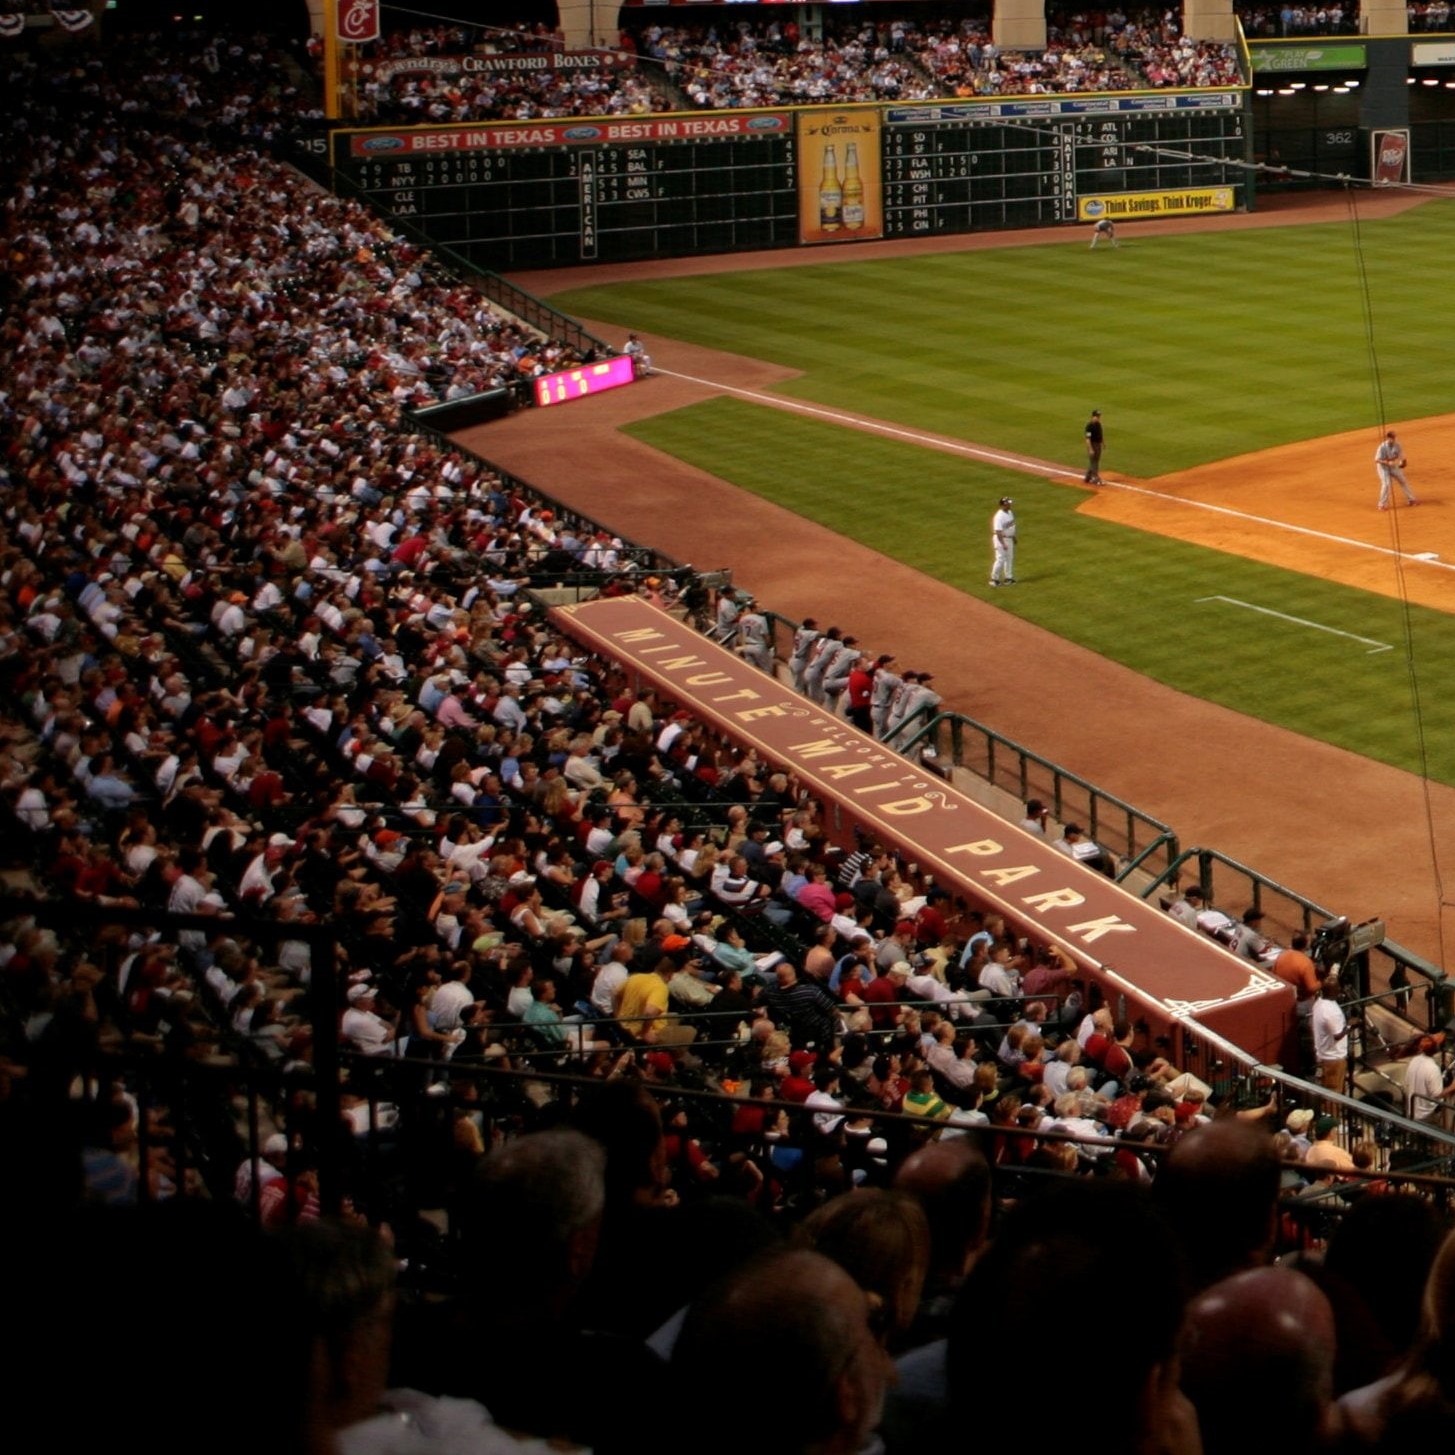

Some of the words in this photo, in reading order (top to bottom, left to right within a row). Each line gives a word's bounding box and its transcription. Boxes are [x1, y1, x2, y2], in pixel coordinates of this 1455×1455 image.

[462, 56, 548, 72] CRAWFORD
[553, 53, 600, 68] BOXES
[820, 124, 861, 137] Corona
[1101, 122, 1118, 132] ATL
[411, 135, 462, 150] BEST
[465, 133, 488, 146] IN
[493, 128, 555, 144] TEXAS
[607, 124, 656, 139] BEST
[657, 122, 678, 137] IN
[682, 119, 740, 134] TEXAS
[913, 132, 926, 143] SD
[1326, 132, 1352, 145] 362
[627, 149, 647, 160] SEA
[627, 161, 647, 172] BAL
[911, 158, 928, 168] FLA
[910, 169, 931, 180] WSH
[1063, 134, 1075, 210] NATIONAL
[391, 175, 417, 188] NYY
[582, 162, 594, 246] AMERICAN
[1105, 199, 1127, 214] Think
[1163, 196, 1184, 210] Think
[809, 718, 898, 770] WELCOME
[899, 773, 929, 789] TO
[612, 627, 788, 722] MINUTE
[788, 738, 935, 816] MAID
[944, 839, 1138, 944] PARK
